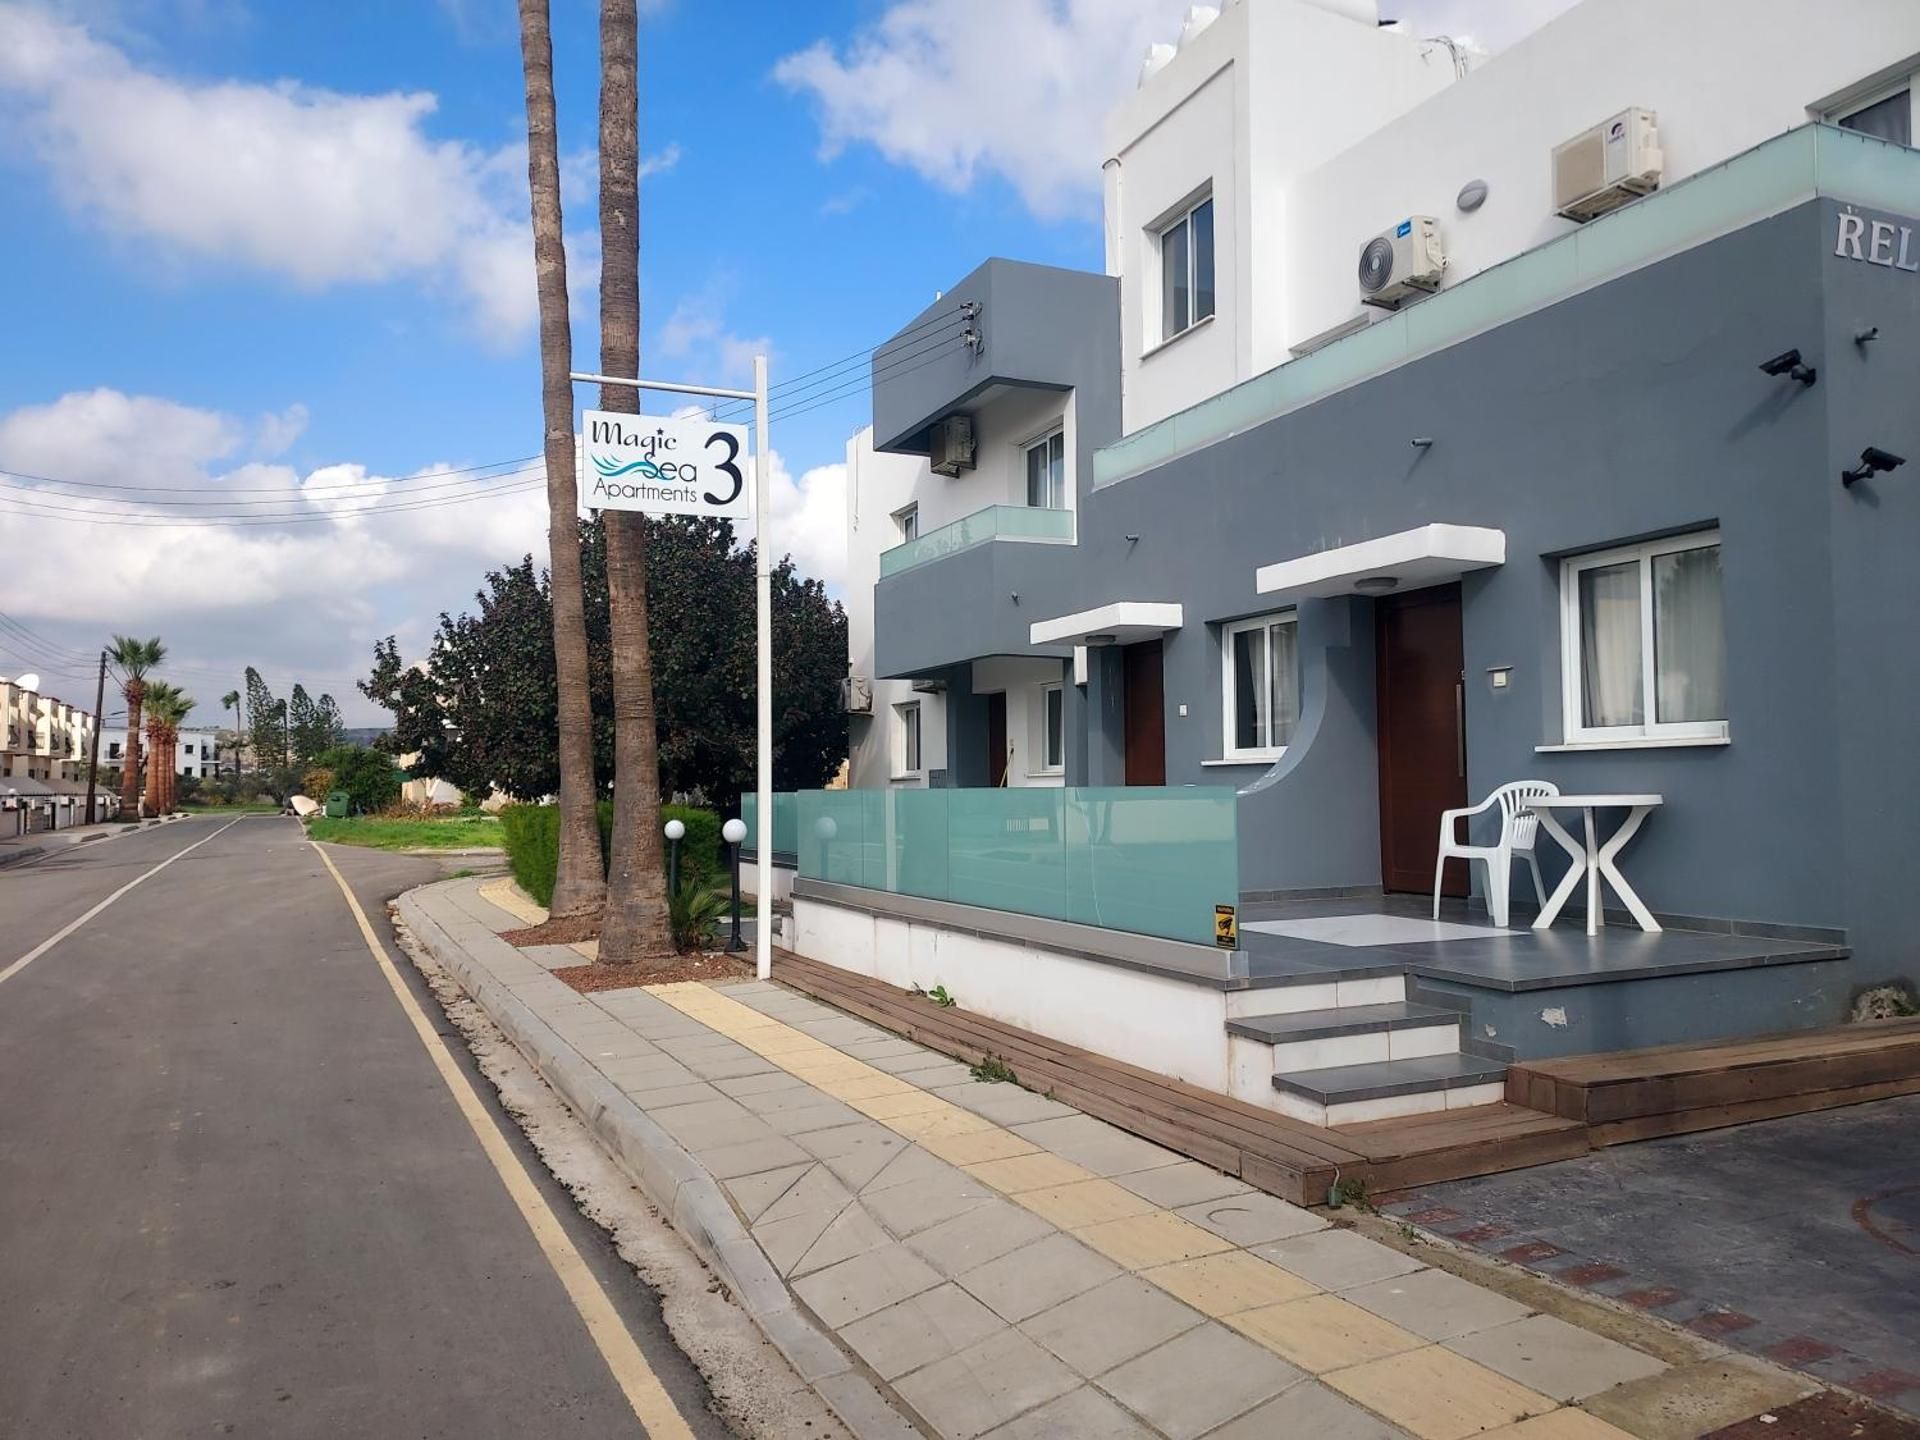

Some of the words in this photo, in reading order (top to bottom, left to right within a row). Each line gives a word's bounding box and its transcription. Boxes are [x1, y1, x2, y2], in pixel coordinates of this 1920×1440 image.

[1835, 213, 1919, 271] REL
[592, 420, 677, 454] Magic
[643, 451, 697, 482] Sea
[703, 431, 743, 505] 3
[593, 477, 697, 503] Apartments
